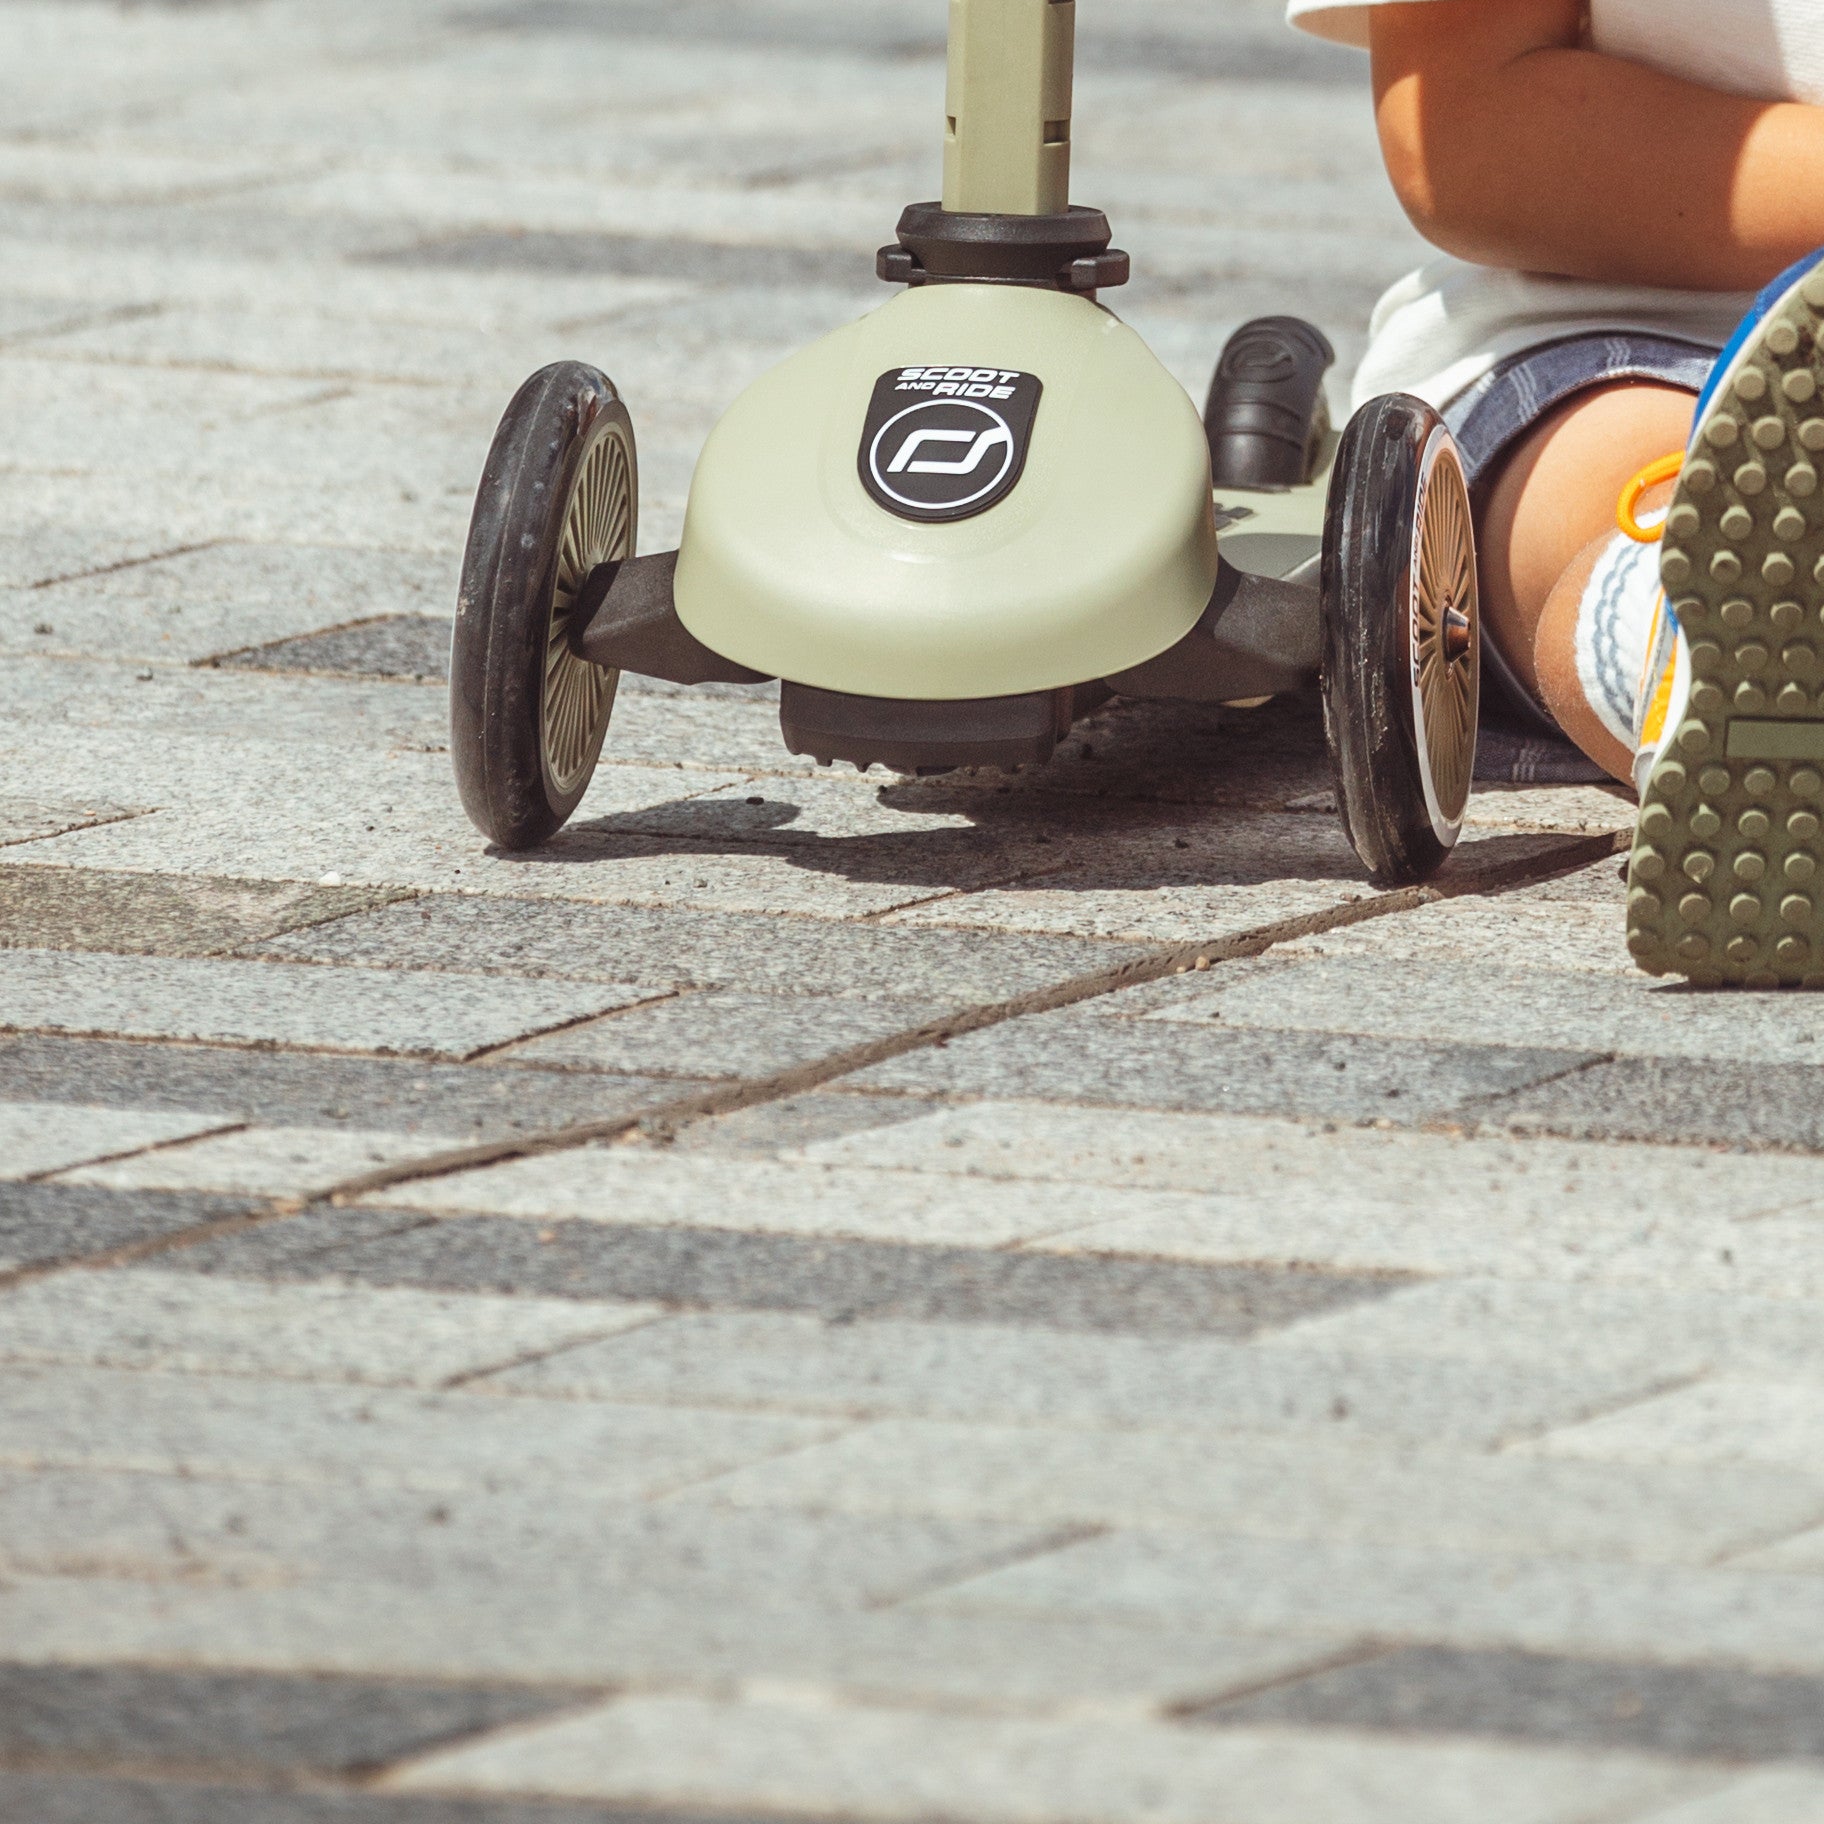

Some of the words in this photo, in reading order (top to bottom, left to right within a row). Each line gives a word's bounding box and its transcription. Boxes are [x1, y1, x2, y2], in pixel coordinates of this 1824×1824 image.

[897, 367, 1020, 384] SCOOT
[895, 382, 935, 391] AND
[932, 382, 1016, 400] RIDE
[1412, 574, 1420, 688] SCOOT
